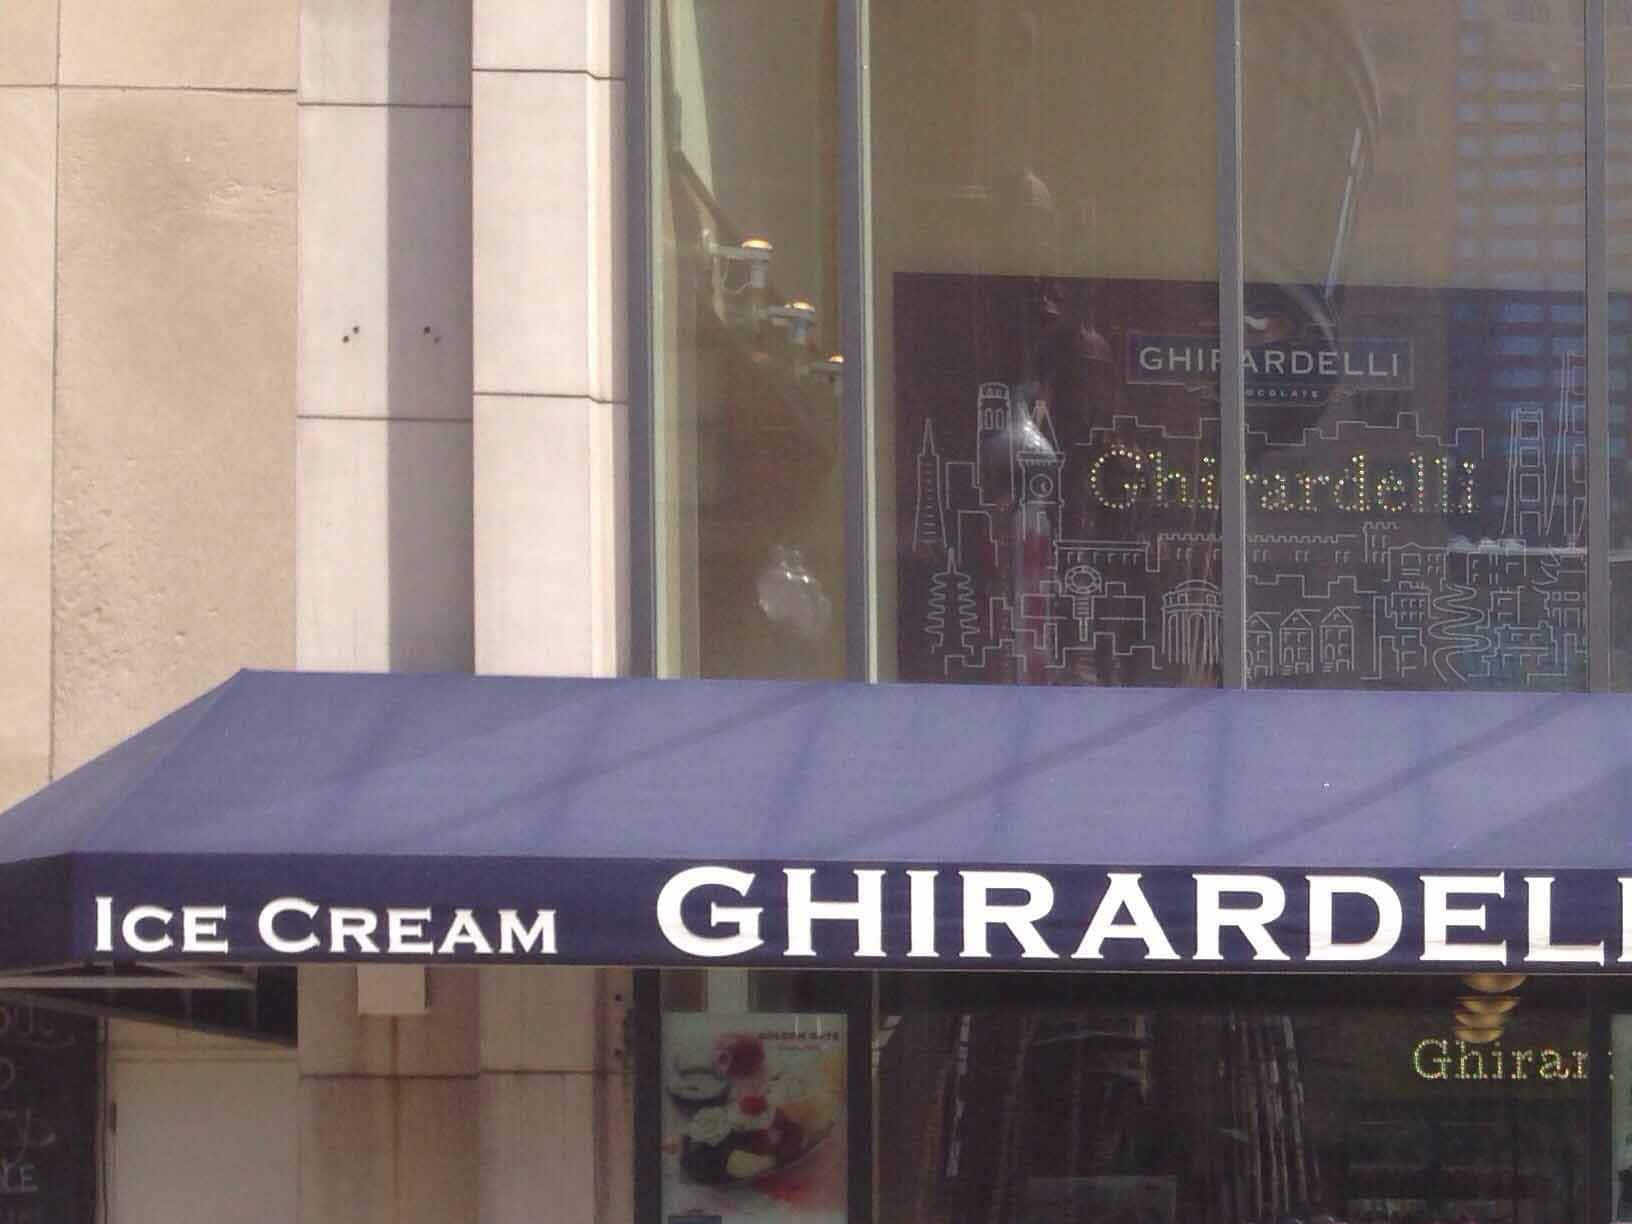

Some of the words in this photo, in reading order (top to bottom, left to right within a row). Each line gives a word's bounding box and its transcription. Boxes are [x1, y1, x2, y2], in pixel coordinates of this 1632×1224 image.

[1090, 444, 1481, 512] Ghiardelli
[95, 896, 229, 954] ICE
[257, 897, 558, 955] CREAM
[1413, 1038, 1613, 1080] Ghirar
